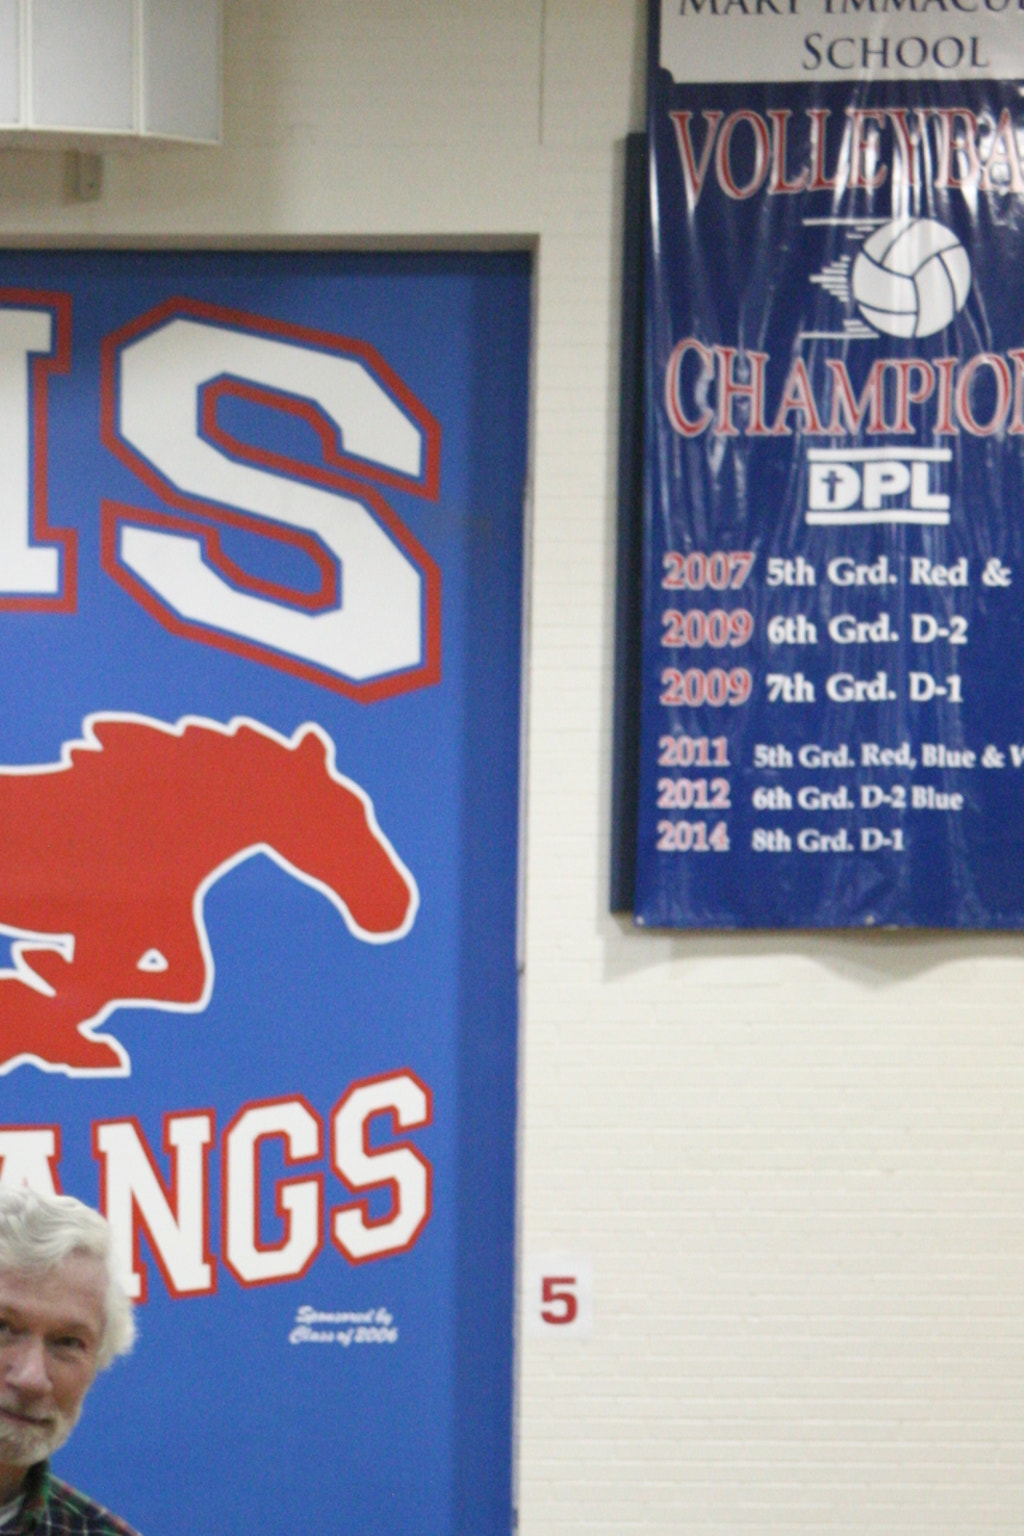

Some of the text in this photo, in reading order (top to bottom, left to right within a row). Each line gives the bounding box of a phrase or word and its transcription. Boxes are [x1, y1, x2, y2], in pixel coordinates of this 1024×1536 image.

[802, 33, 990, 71] SCHOOL
[809, 460, 950, 511] DPL
[662, 551, 1013, 590] 2007 5th Grd. Red &
[661, 608, 969, 648] 2009 6th Grd. D-2
[660, 667, 964, 707] 2009 7th Grd. D-1
[658, 736, 731, 767] 2011
[753, 744, 794, 769] 5th
[798, 744, 855, 769] Grd.
[921, 743, 977, 769] Blue
[981, 743, 1006, 769] &
[657, 778, 964, 812] 2012 6th Grd. D-2 Blue
[657, 821, 906, 853] 2014 8th Grd. D-1
[541, 1276, 579, 1325] 5
